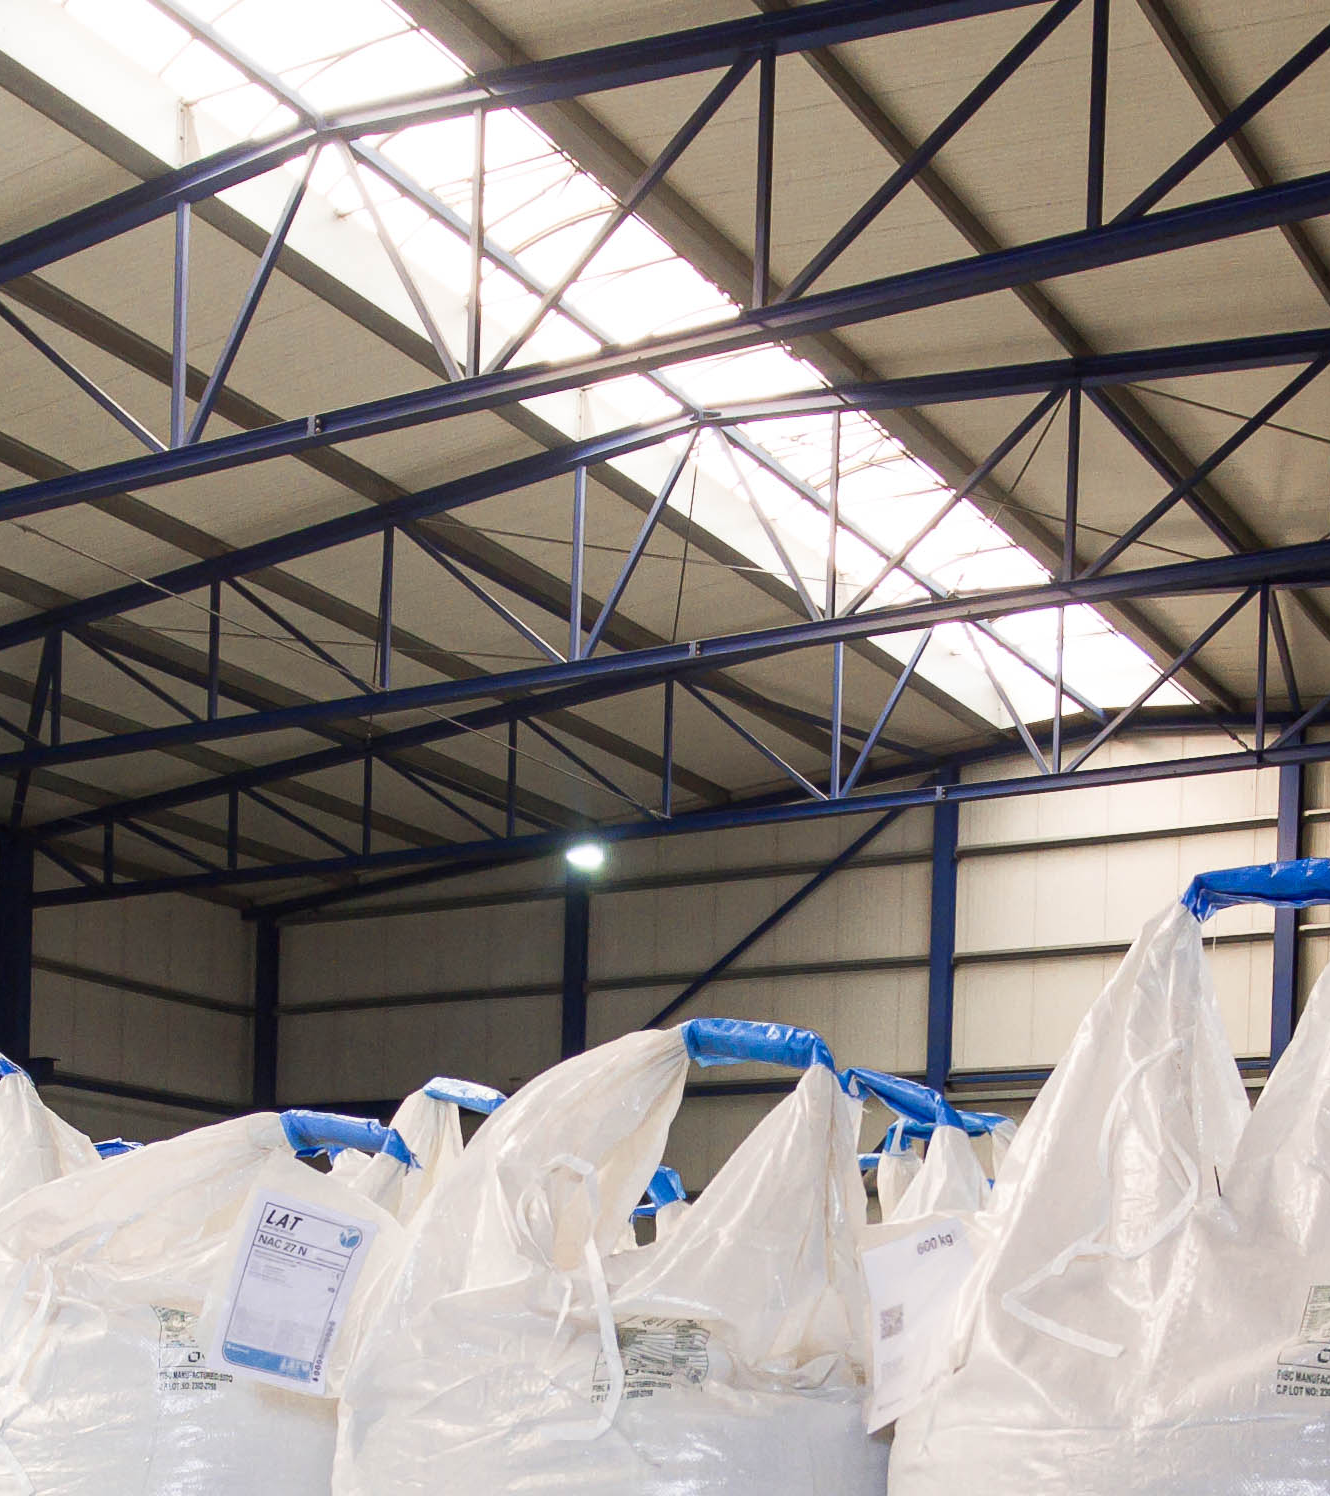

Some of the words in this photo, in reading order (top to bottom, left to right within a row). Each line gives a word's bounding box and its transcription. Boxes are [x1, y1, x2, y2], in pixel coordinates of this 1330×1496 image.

[266, 1209, 303, 1231] LAT
[257, 1234, 282, 1250] NAC
[283, 1242, 296, 1254] 27
[297, 1246, 308, 1257] N
